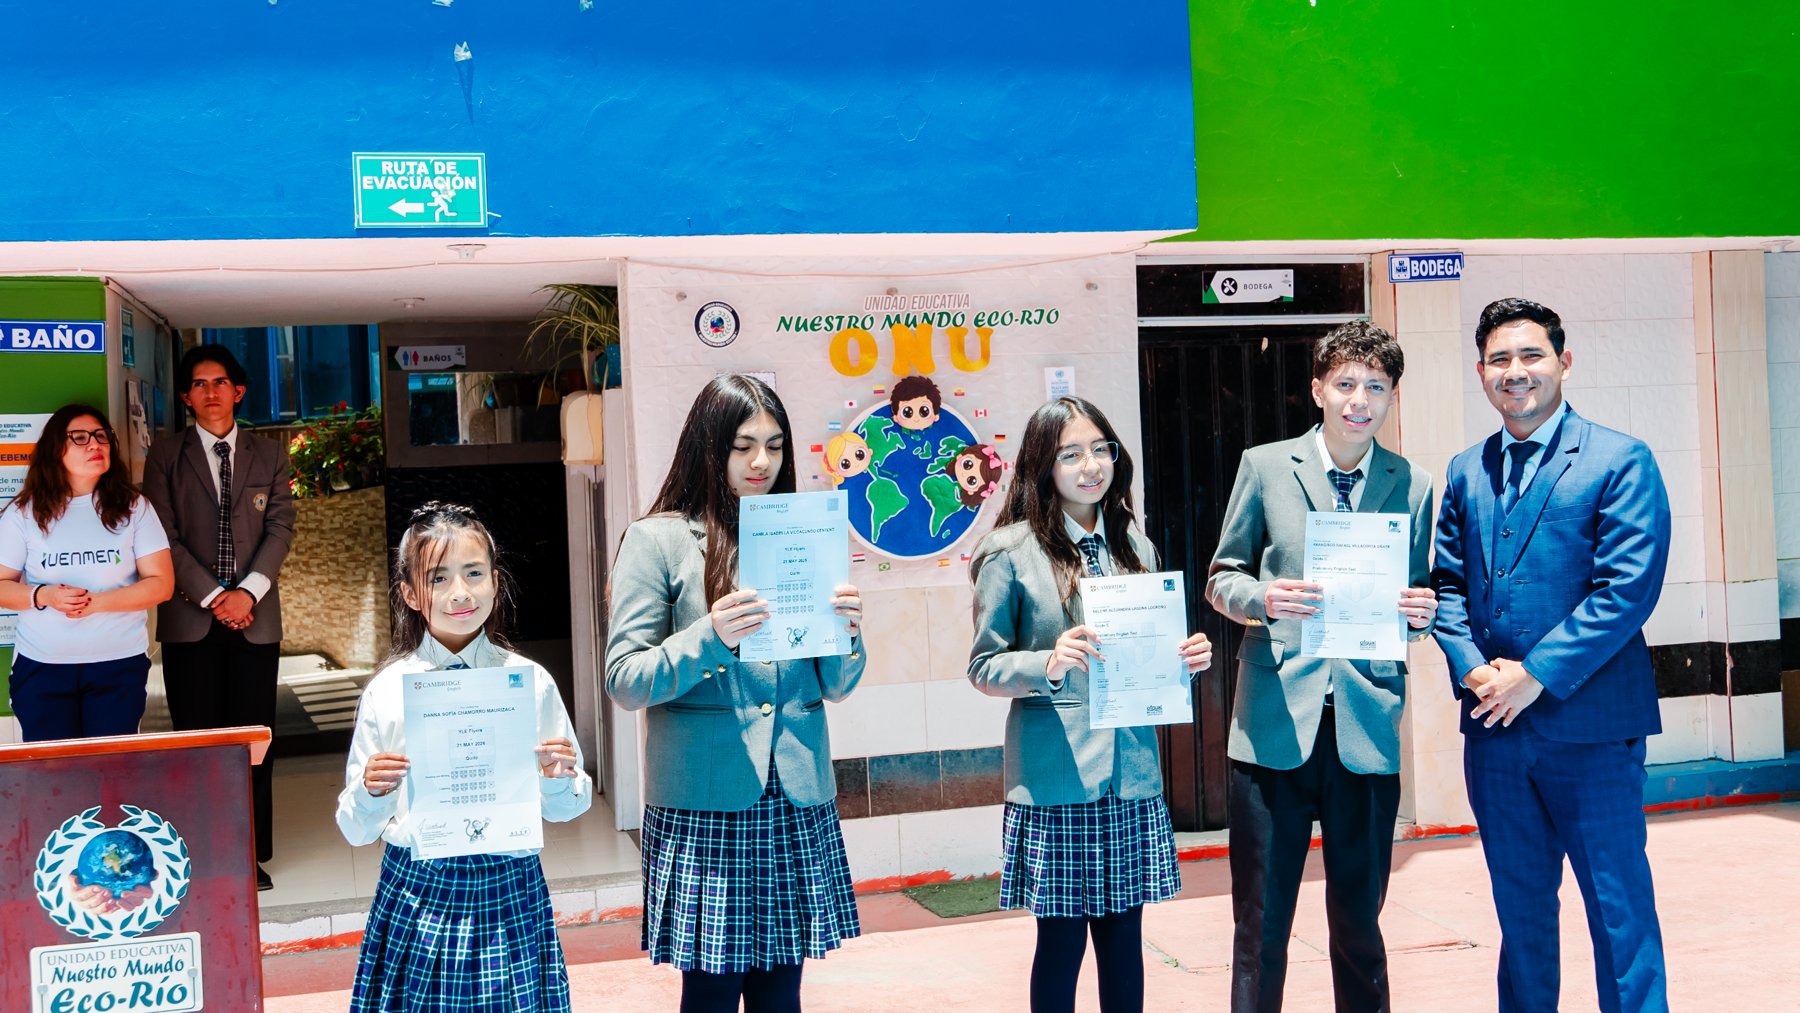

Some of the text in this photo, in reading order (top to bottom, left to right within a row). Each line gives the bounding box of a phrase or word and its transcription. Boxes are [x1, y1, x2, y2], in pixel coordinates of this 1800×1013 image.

[382, 161, 456, 174] RUTA DE
[362, 173, 476, 190] EVACUACIÓN
[1411, 258, 1460, 276] BODEGA
[864, 294, 970, 310] UNIDAD EDUCATIVA
[776, 314, 874, 332] NUESTRO
[880, 311, 966, 330] MUNDO
[12, 324, 96, 349] BAÑO
[423, 354, 452, 362] BAÑOS
[829, 323, 994, 376] ONU
[47, 944, 186, 966] UNIDAD EDUCATIVA
[52, 955, 184, 984] Nuestro Mundo
[50, 976, 188, 1013] Eco-Río
